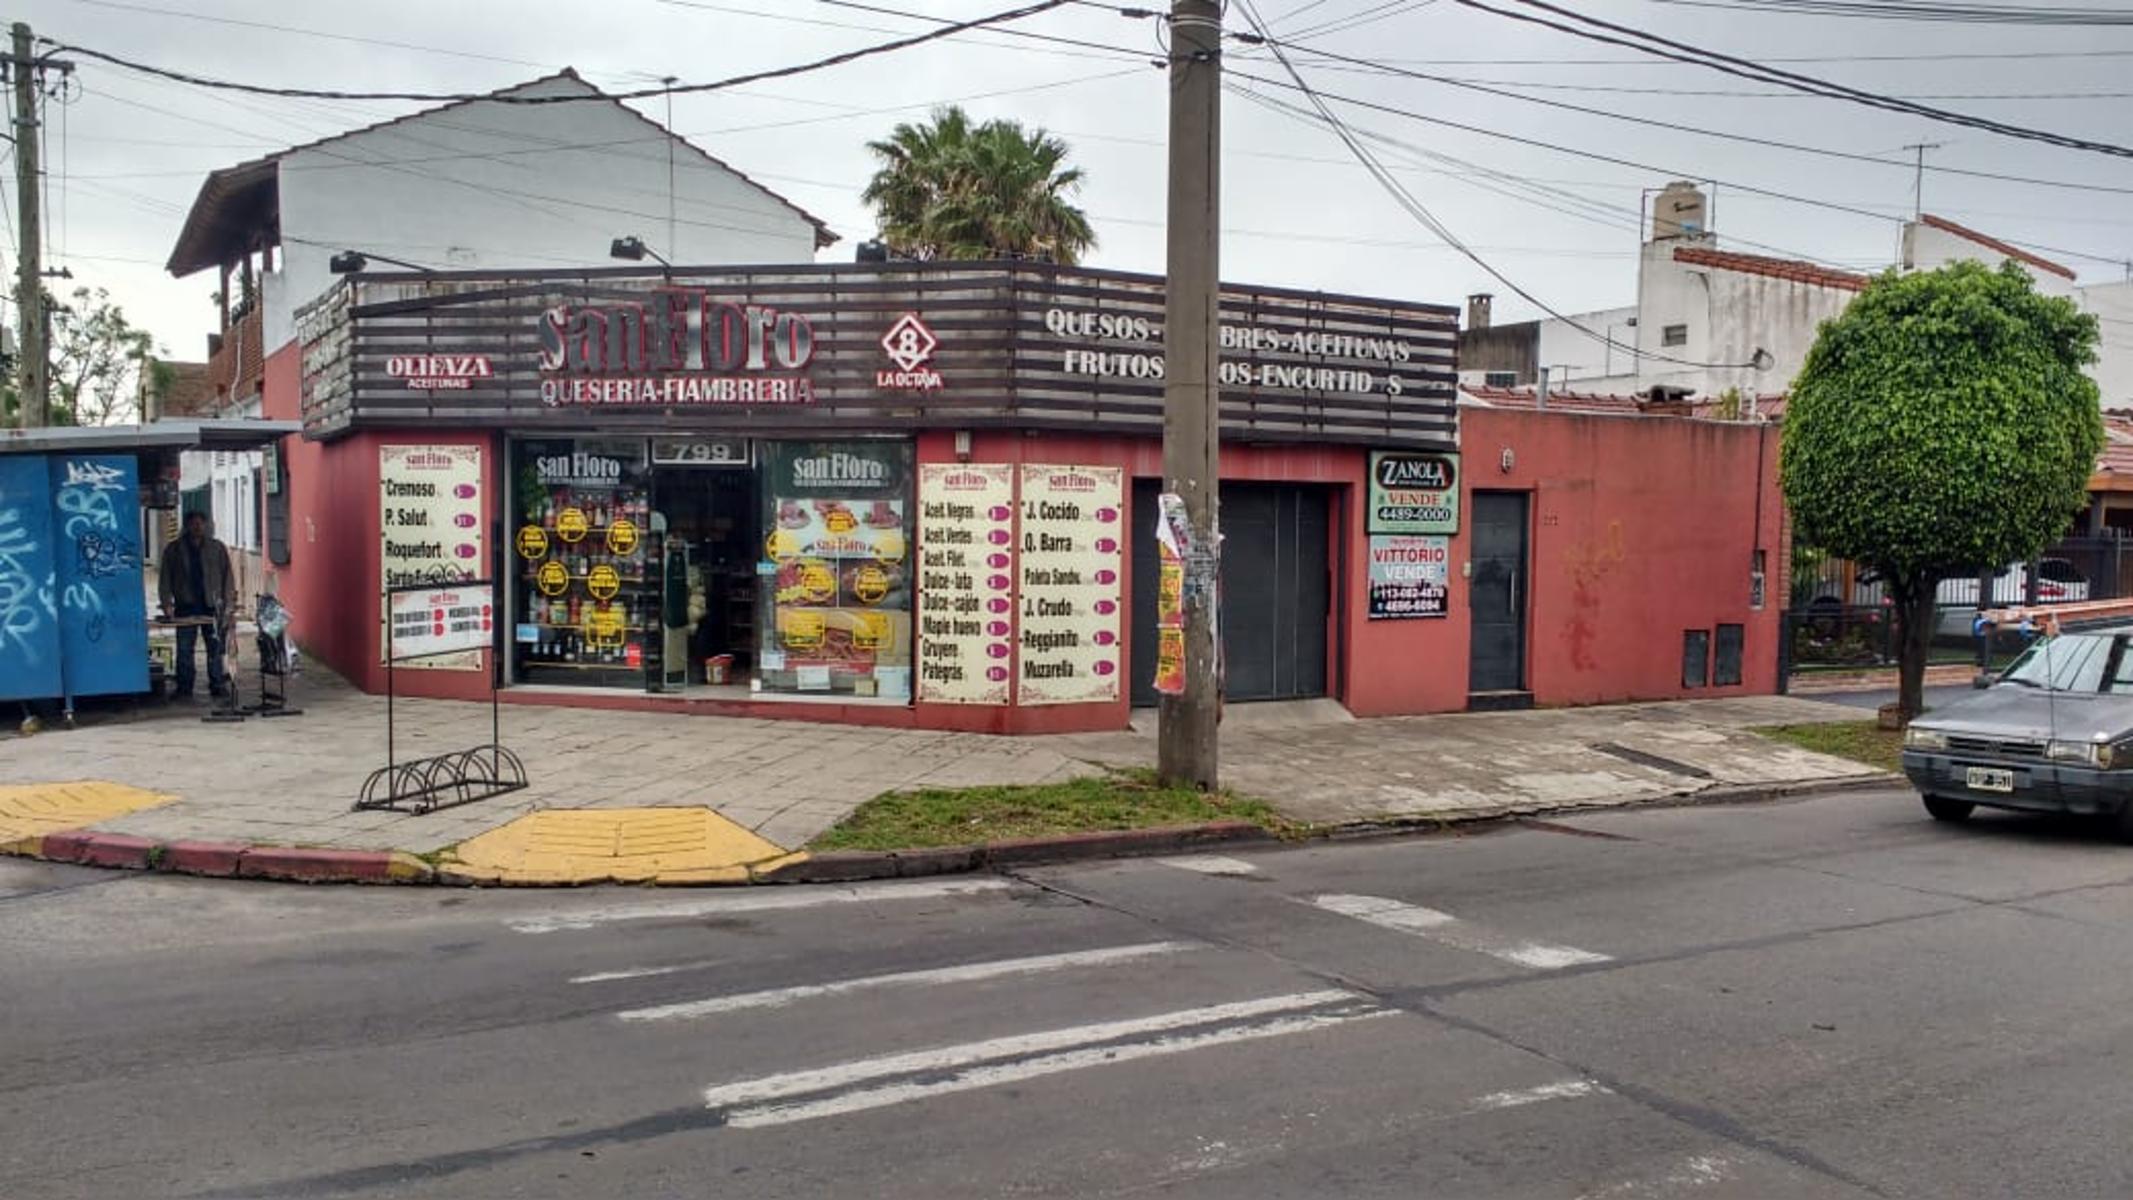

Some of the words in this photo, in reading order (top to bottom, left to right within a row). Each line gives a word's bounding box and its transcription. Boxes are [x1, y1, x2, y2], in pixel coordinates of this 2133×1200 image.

[1064, 350, 1165, 380] FRUTOS
[407, 378, 471, 390] ACEITUNAS
[673, 444, 730, 461] 799
[1382, 460, 1446, 487] ZANOLA
[386, 478, 436, 497] Cremoso
[1388, 492, 1441, 505] VENDE
[398, 508, 428, 527] Salut
[947, 502, 975, 522] Negras
[1040, 501, 1080, 520] Cocido
[385, 540, 442, 560] Roquefort
[1040, 533, 1072, 552] Barra
[1374, 548, 1444, 562] VITTORIO
[1384, 565, 1436, 579] VENDE
[1038, 597, 1072, 617] Crudo
[1024, 629, 1078, 652] Reggianito
